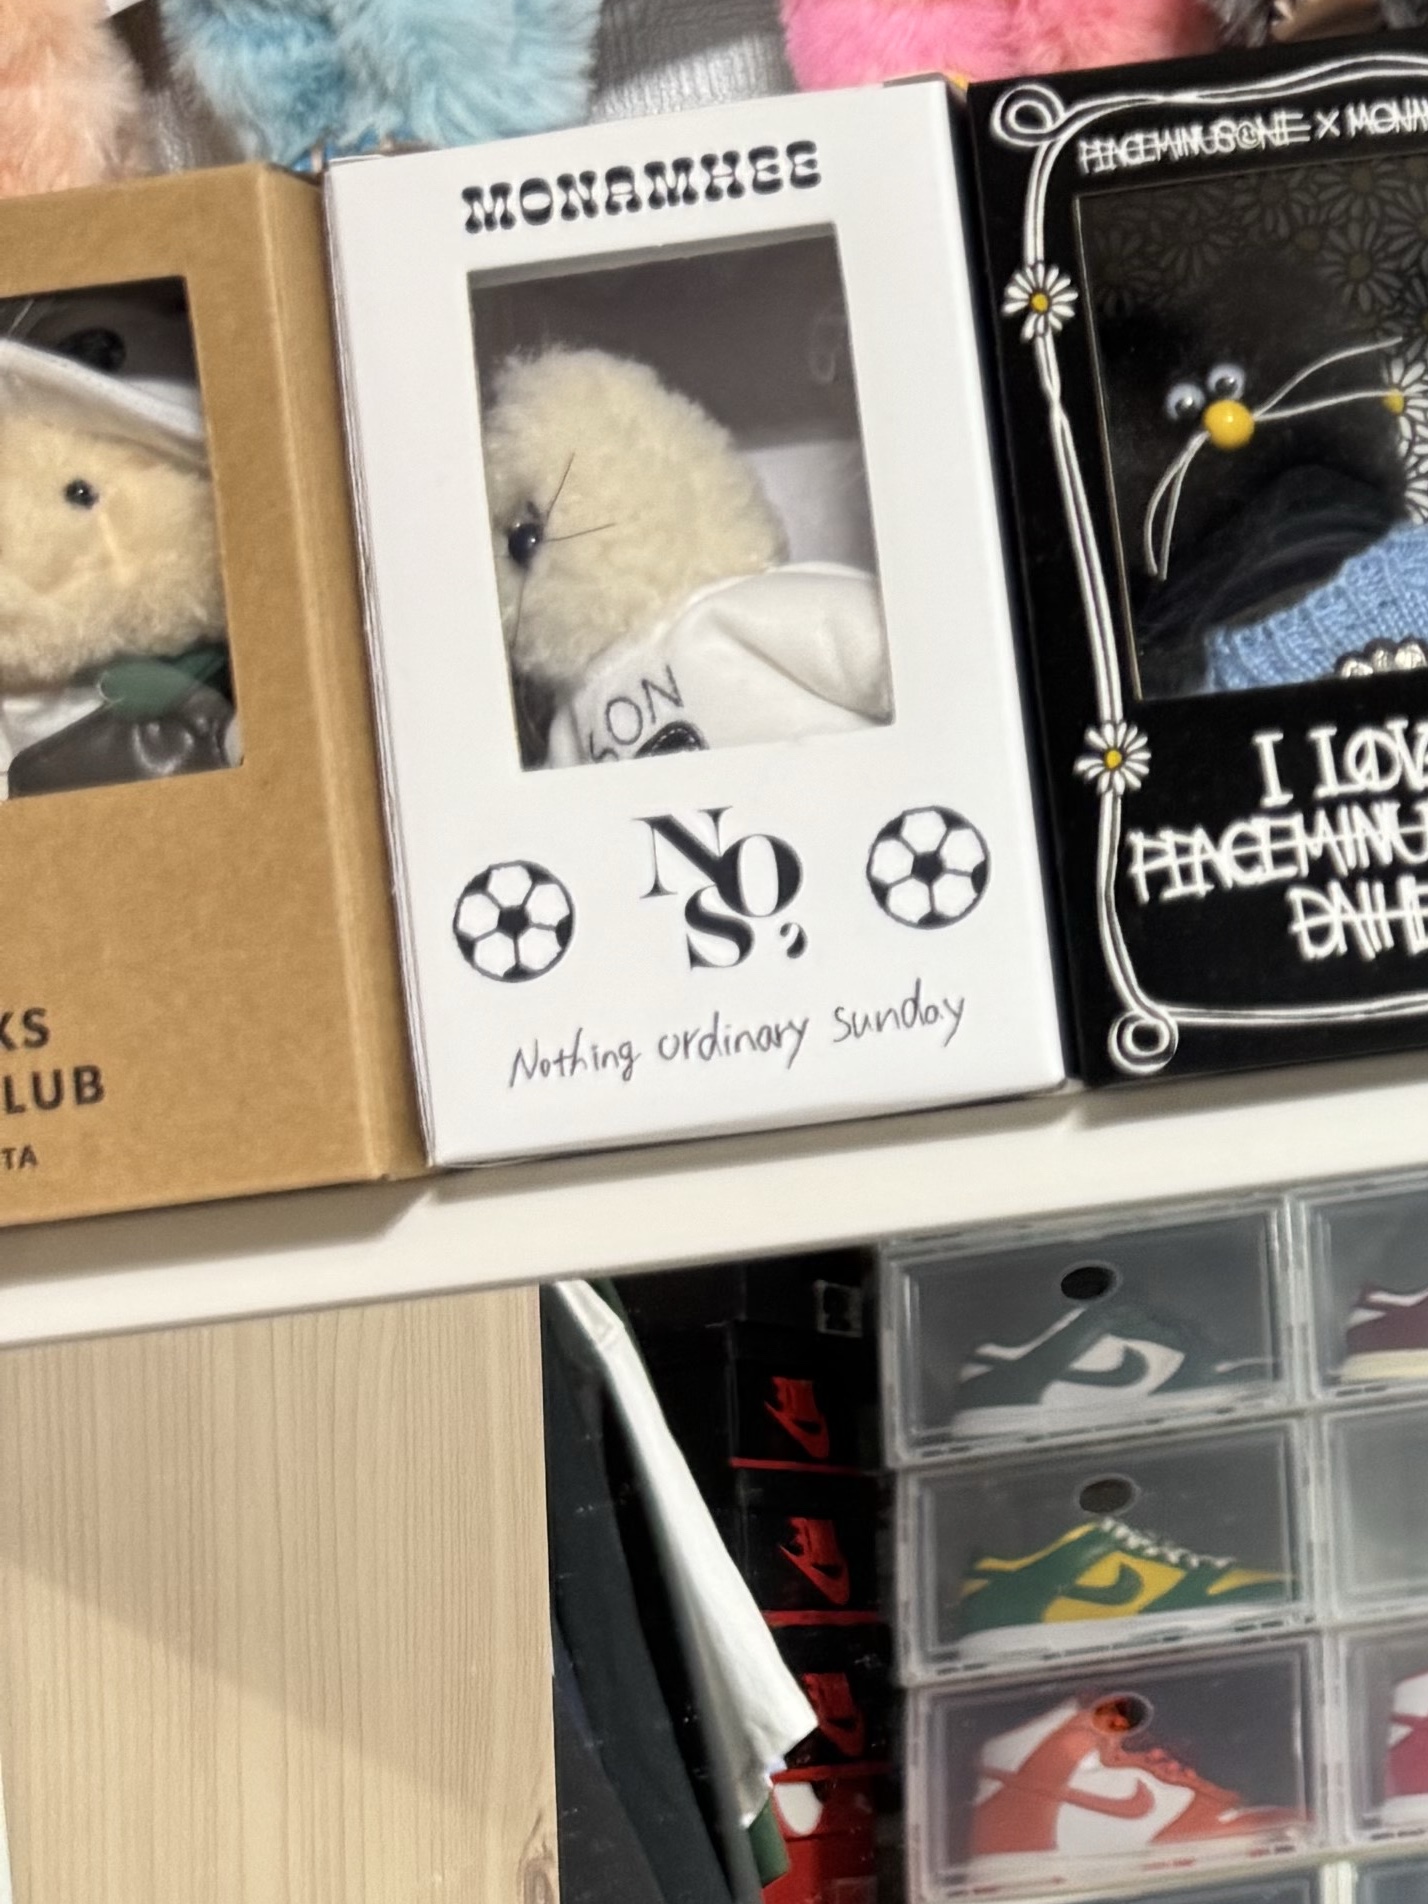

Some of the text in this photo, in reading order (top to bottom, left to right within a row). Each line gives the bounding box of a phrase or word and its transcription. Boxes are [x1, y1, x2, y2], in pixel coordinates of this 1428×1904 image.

[461, 139, 822, 234] MONAMHEE
[1252, 730, 1294, 808] I
[508, 1027, 643, 1088] Nothing
[657, 1009, 810, 1070] ordinary
